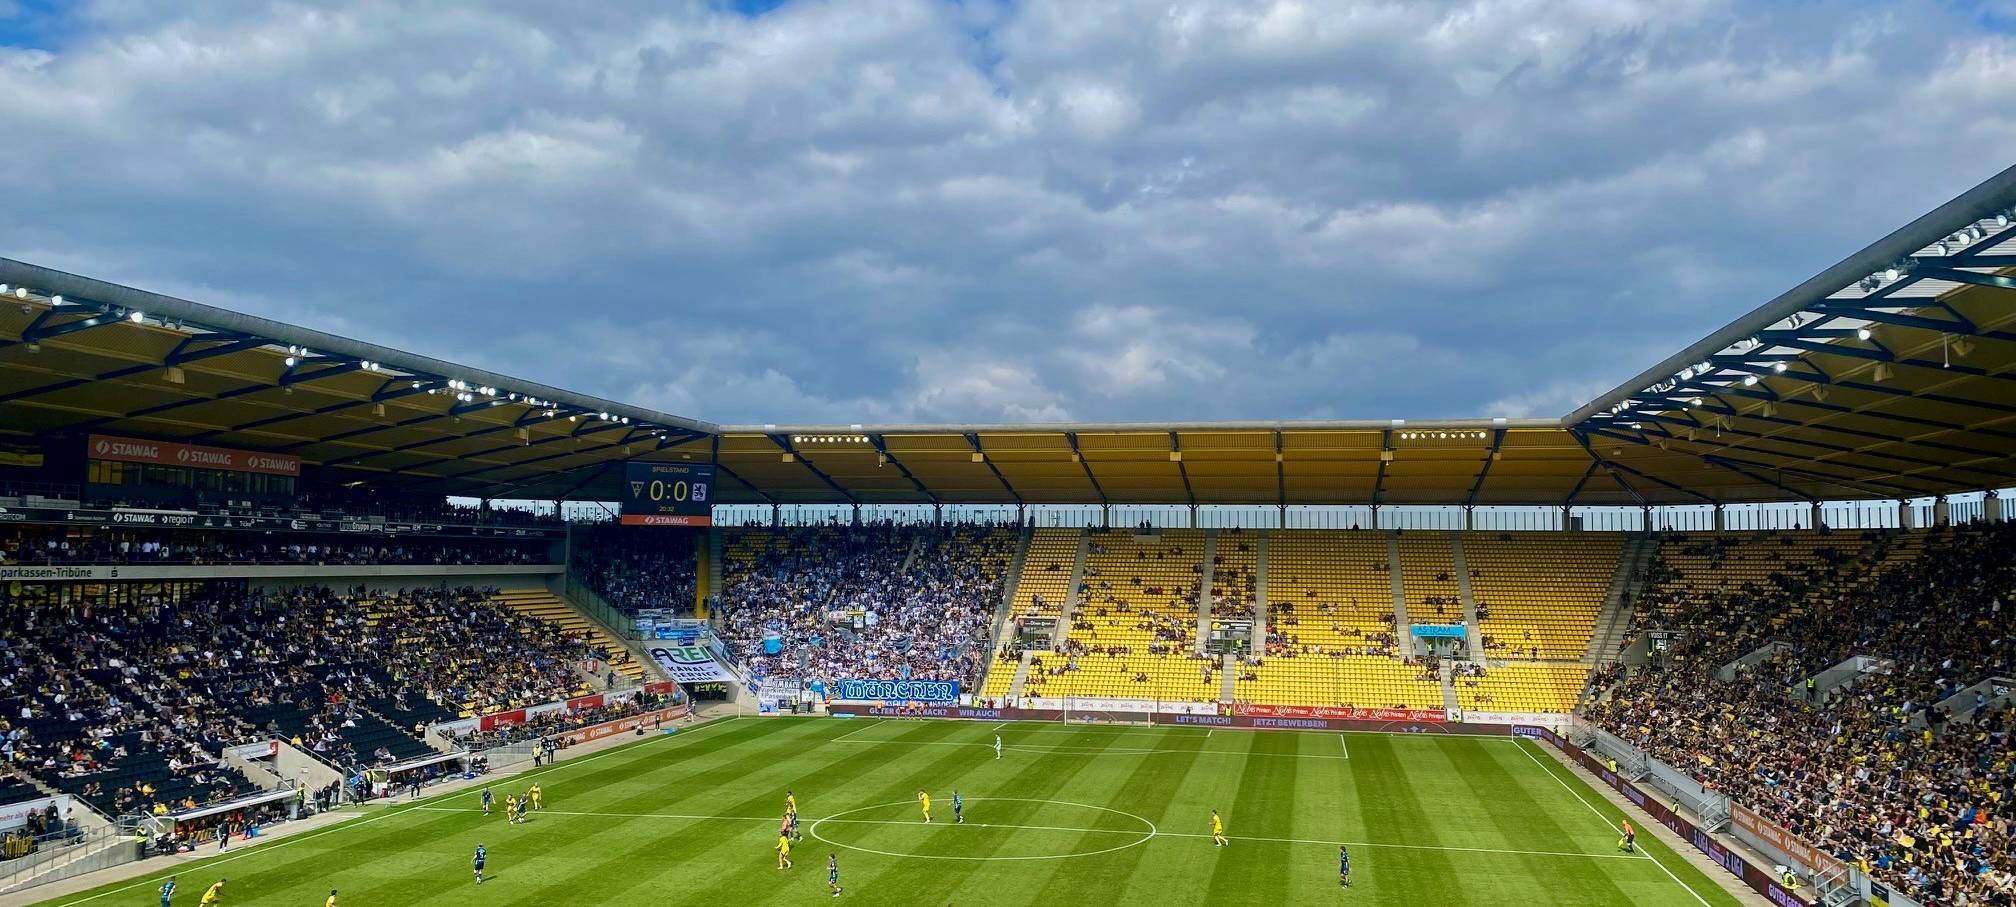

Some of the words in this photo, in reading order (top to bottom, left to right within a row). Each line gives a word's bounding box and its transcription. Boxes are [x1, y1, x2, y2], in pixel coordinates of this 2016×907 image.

[111, 443, 158, 459] STAWAG
[191, 451, 231, 465] STAWAG
[260, 458, 295, 471] STAWAG
[123, 514, 155, 523] STAWAG
[655, 517, 689, 525] STAWAG
[959, 709, 972, 717] WIR
[973, 710, 1001, 718] AUCH!
[1198, 716, 1231, 725] MATCH!
[1253, 719, 1276, 727] JETZT
[1278, 719, 1327, 728] BEWERBEN!
[1514, 727, 1541, 735] GUTER
